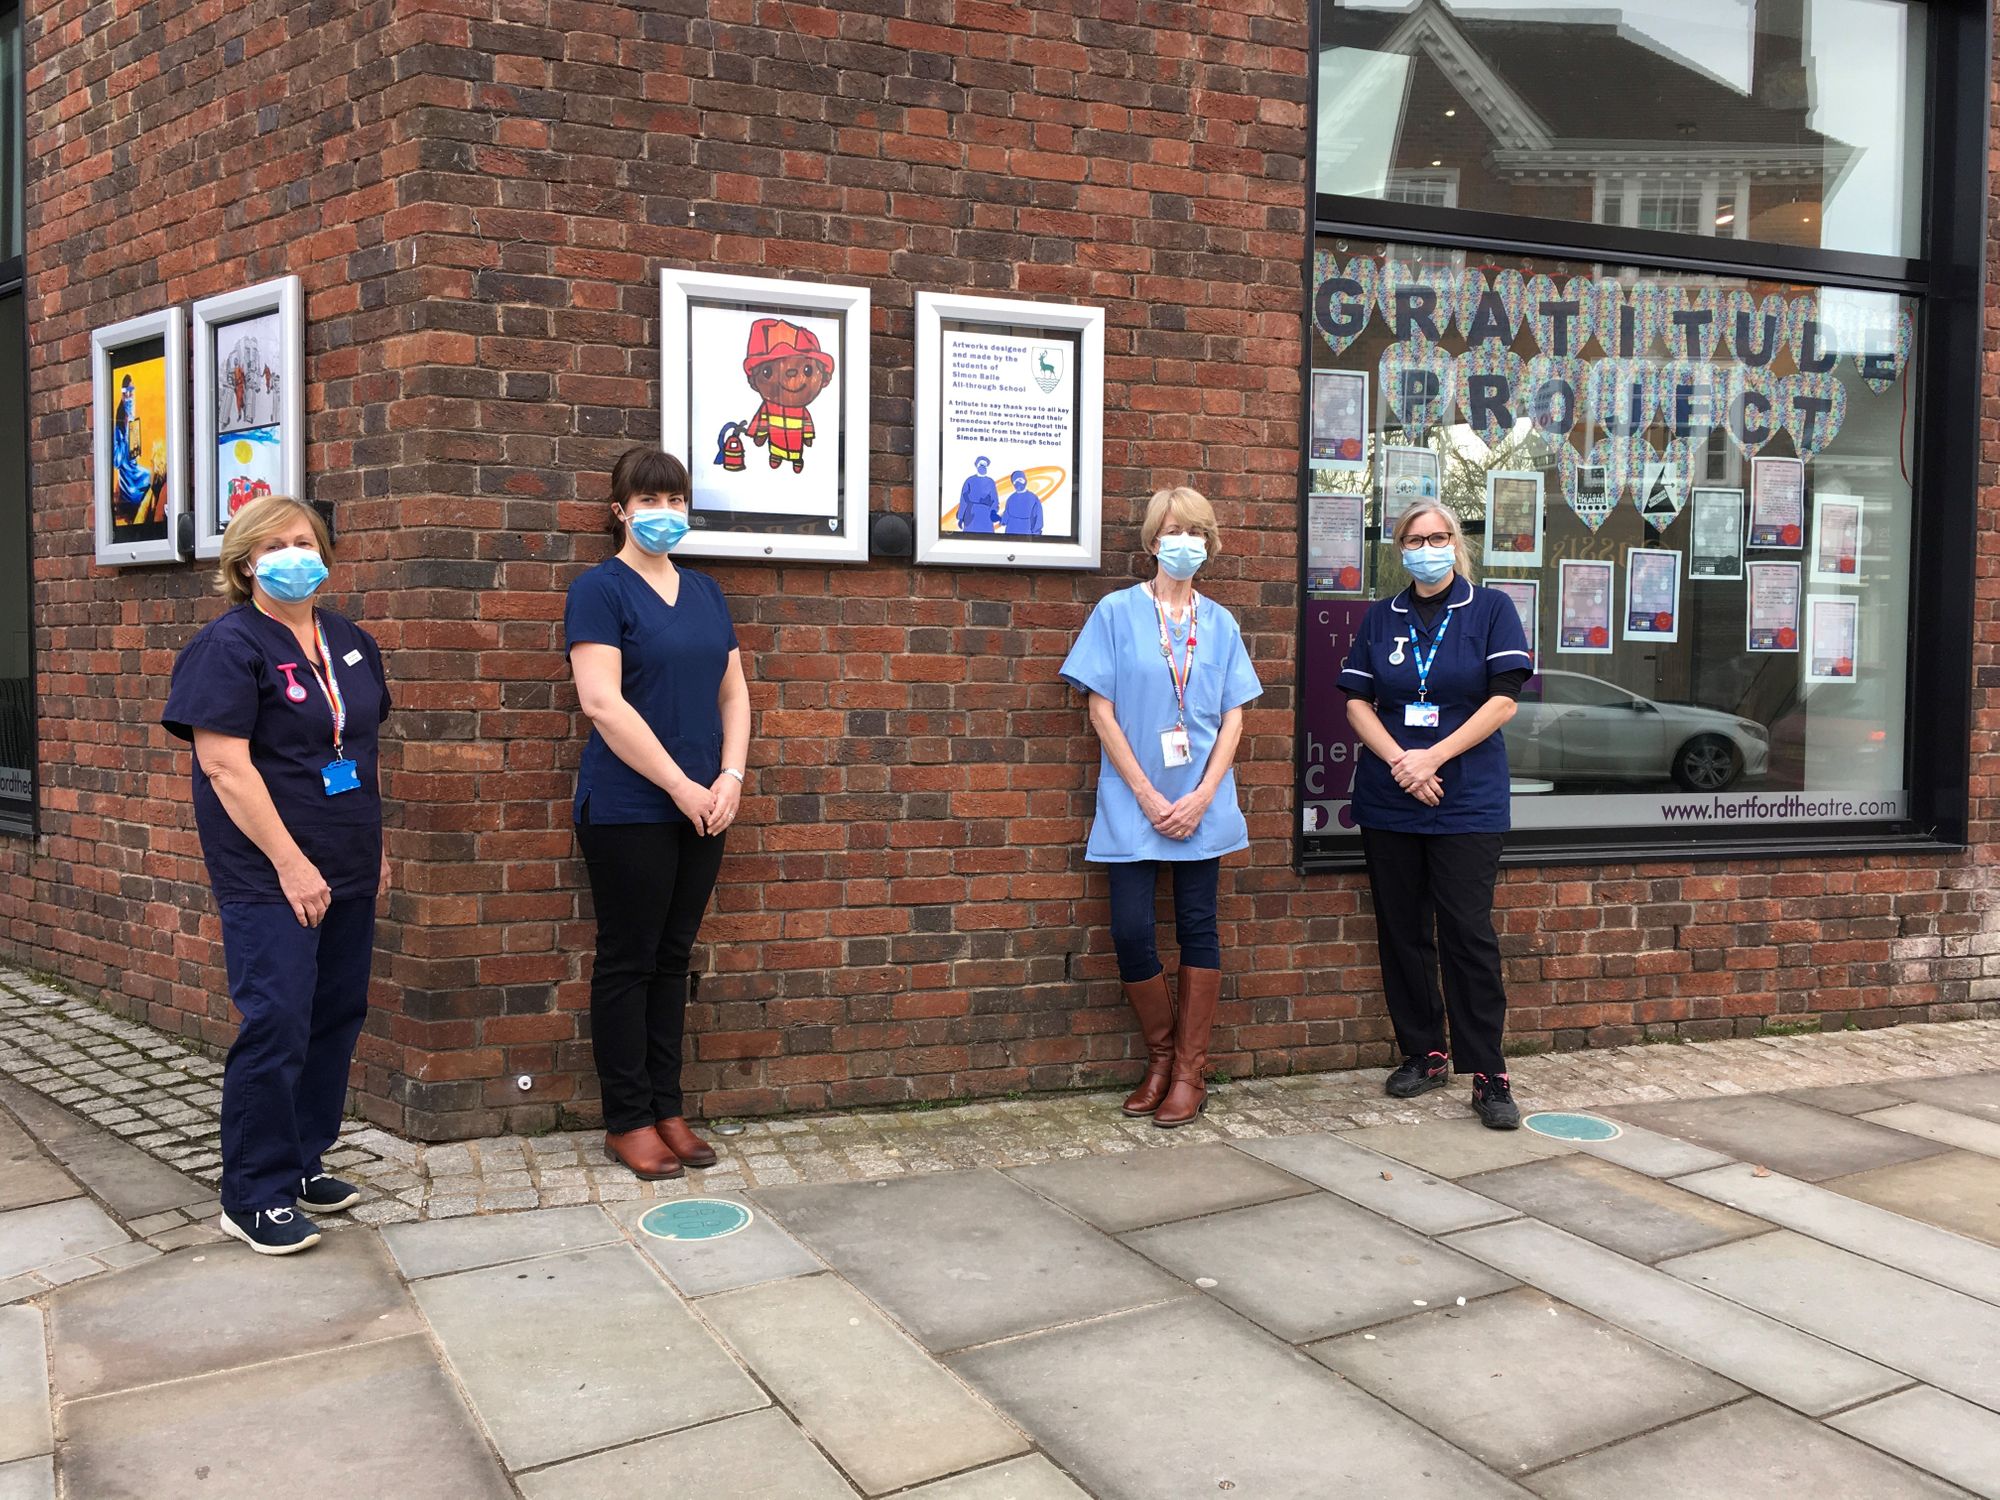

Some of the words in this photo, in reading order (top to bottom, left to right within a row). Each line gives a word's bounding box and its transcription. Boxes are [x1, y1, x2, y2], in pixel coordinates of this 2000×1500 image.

[1315, 277, 1896, 381] GRATITUDE
[952, 341, 988, 350] Artworks
[990, 344, 1027, 354] designed
[970, 352, 992, 360] made
[994, 354, 1002, 362] by
[952, 362, 988, 370] students
[952, 371, 978, 379] Simon
[952, 381, 997, 391] All-through
[999, 384, 1026, 392] School
[1401, 369, 1832, 450] PROJECT
[999, 437, 1036, 445] All-through
[338, 712, 346, 732] NHS
[1661, 795, 1896, 820] www.hertfordtheatre.com
